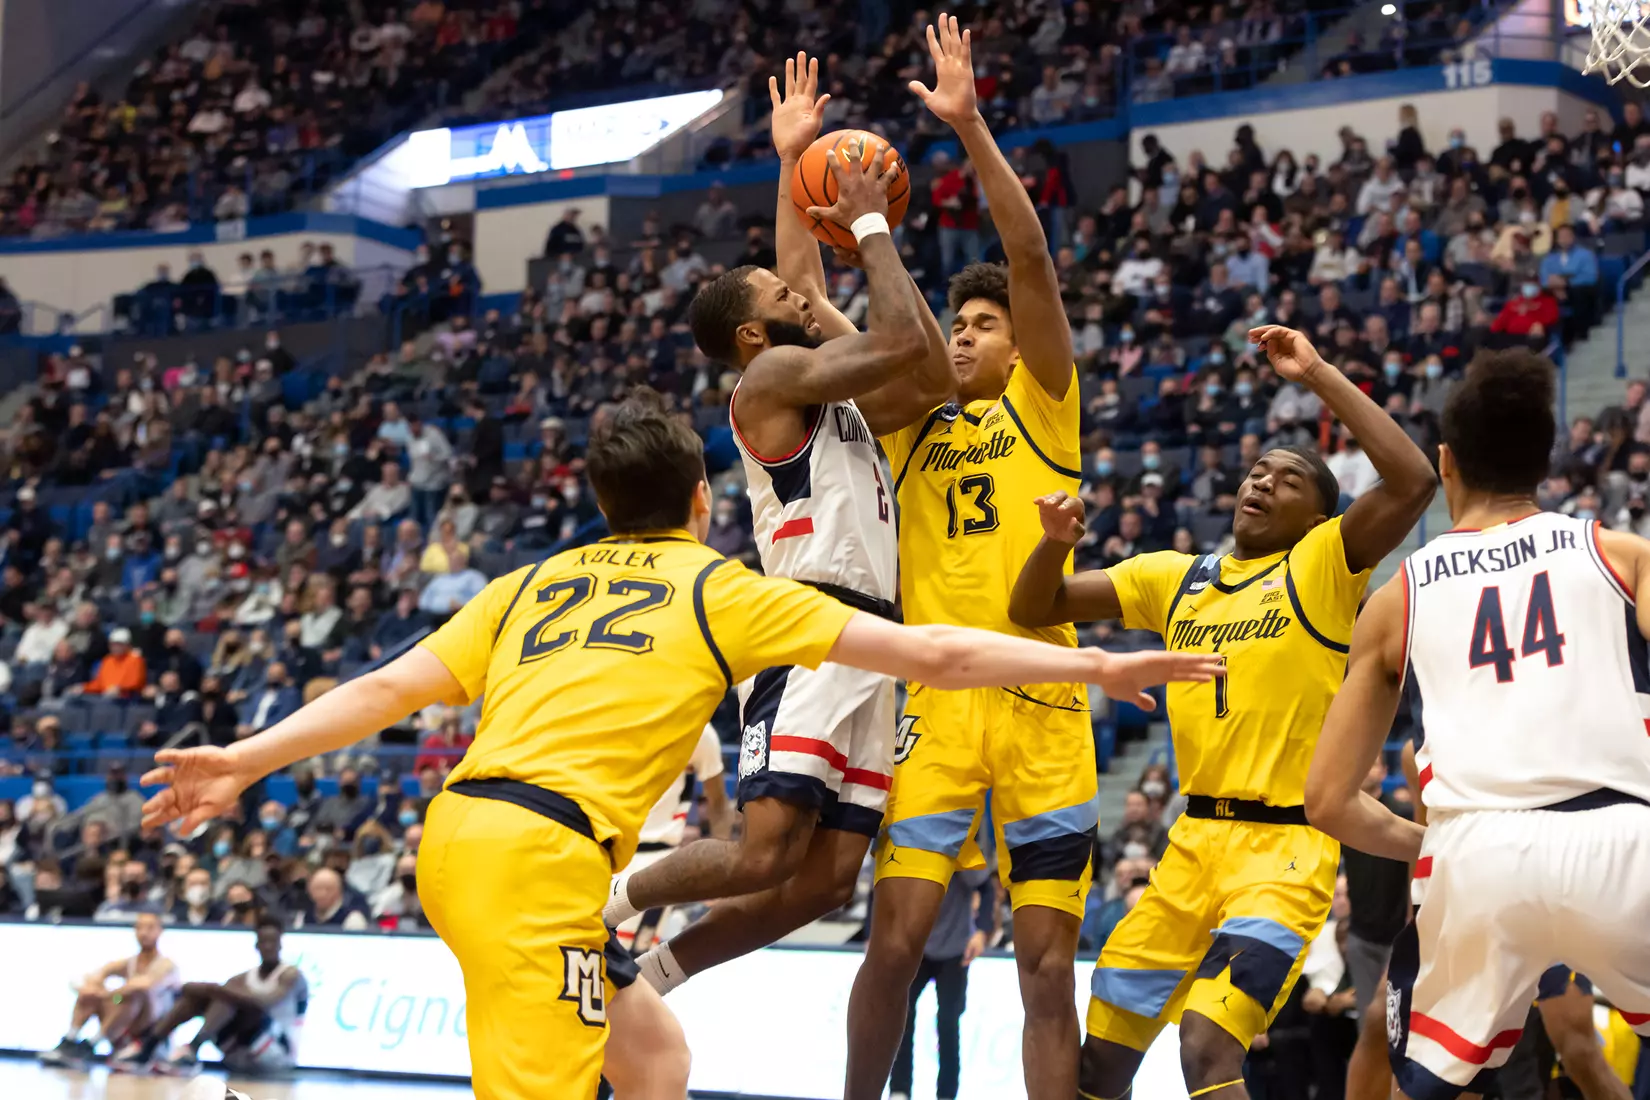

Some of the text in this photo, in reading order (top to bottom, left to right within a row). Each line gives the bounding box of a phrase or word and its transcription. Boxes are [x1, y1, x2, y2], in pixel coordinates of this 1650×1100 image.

[1441, 60, 1493, 88] 115
[919, 428, 1017, 472] Maruette
[873, 461, 889, 524] 2
[946, 472, 1000, 539] 13
[1419, 534, 1537, 588] JACKSON
[518, 572, 676, 666] 22
[1169, 608, 1292, 653] Marquette
[1469, 570, 1566, 684] 44
[1215, 656, 1230, 718] 1
[1215, 799, 1235, 818] AL
[557, 945, 607, 1029] MU
